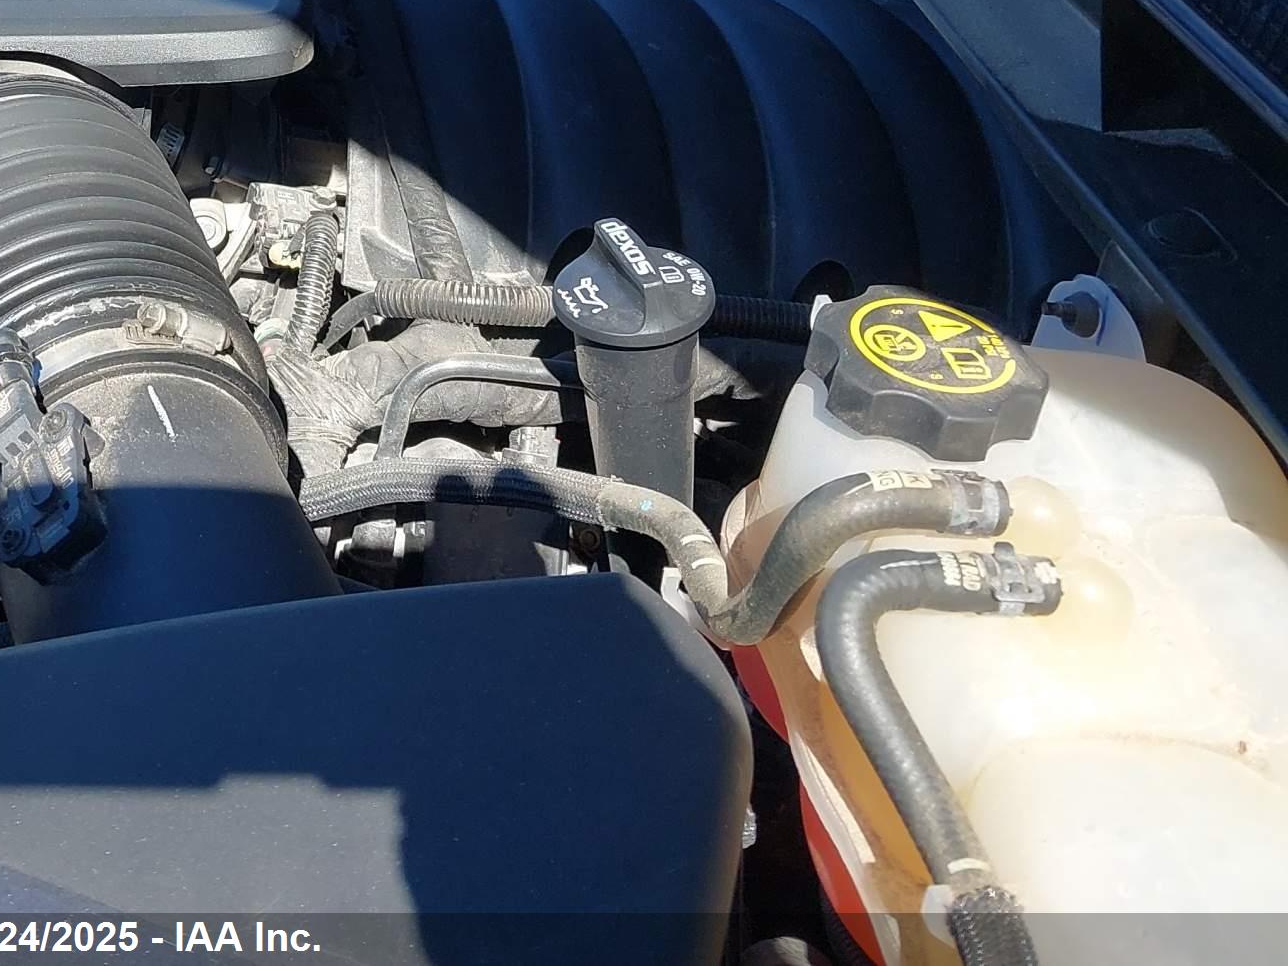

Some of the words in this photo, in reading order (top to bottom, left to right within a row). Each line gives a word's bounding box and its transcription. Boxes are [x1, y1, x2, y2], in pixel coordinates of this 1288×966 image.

[601, 221, 657, 276] dexos
[662, 252, 692, 267] SAE
[686, 267, 707, 296] 0W-20
